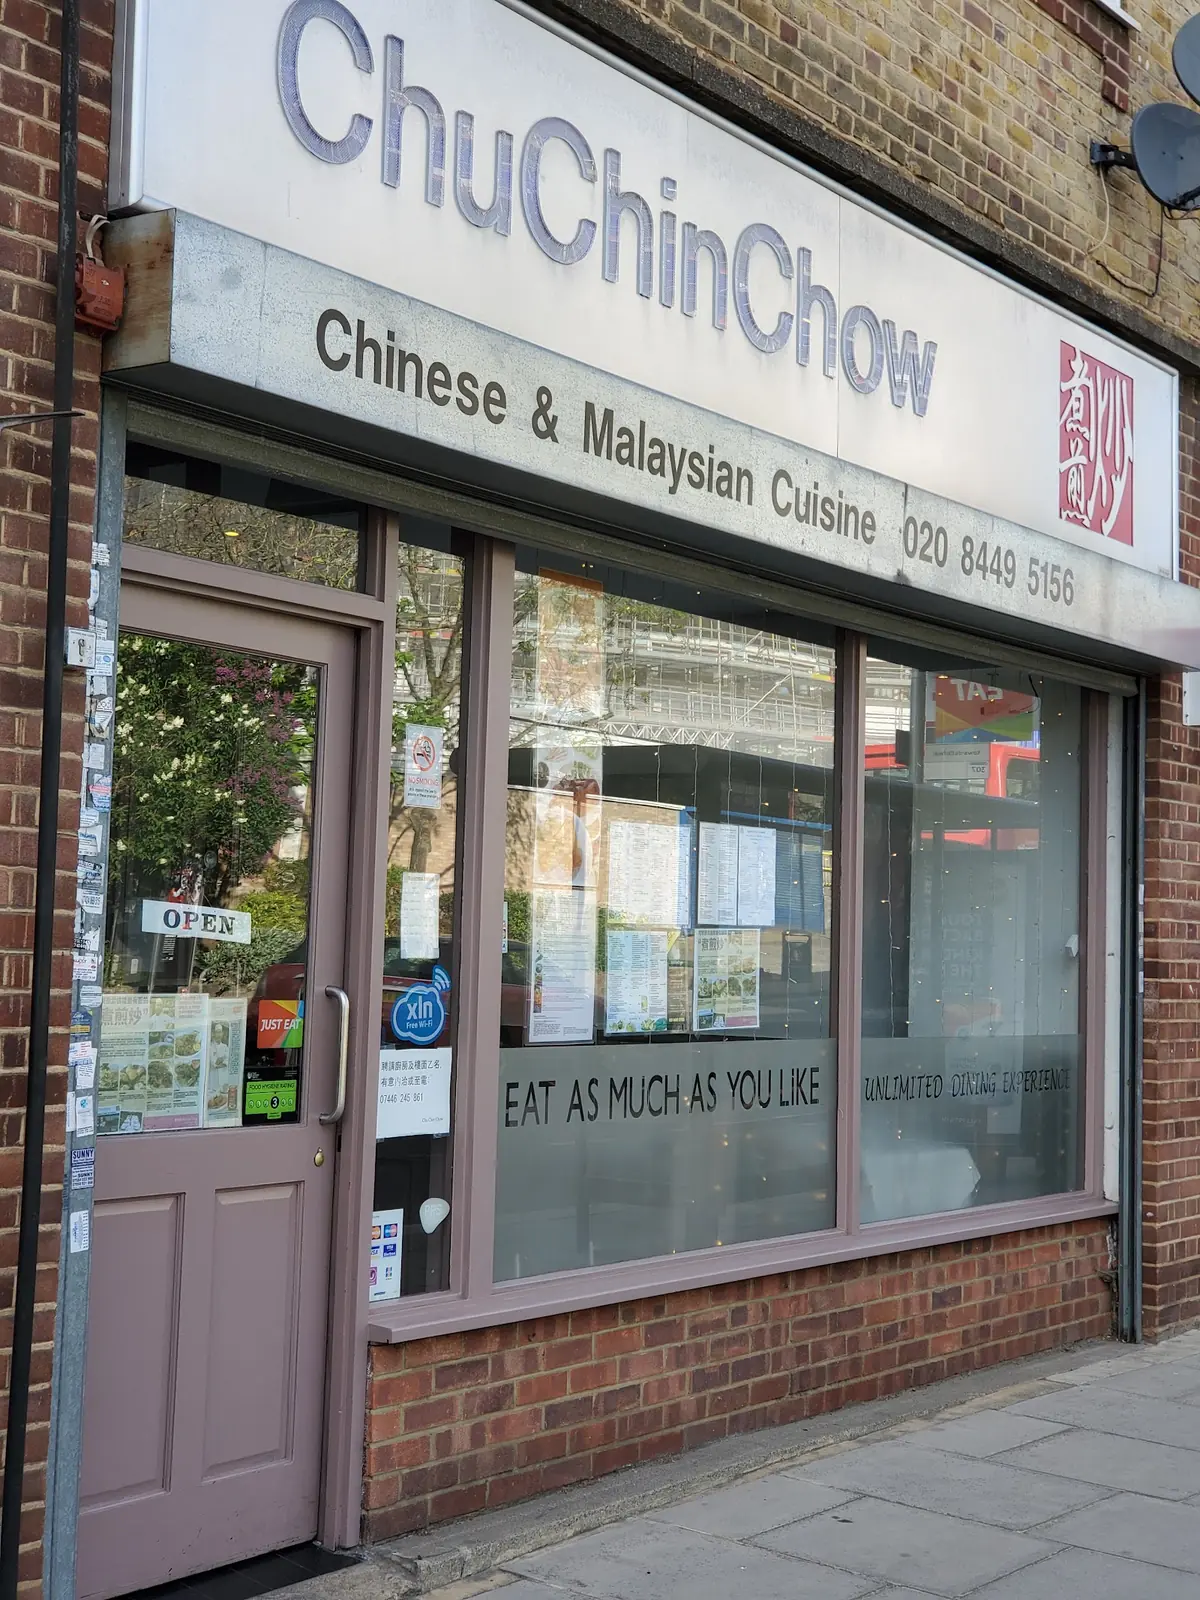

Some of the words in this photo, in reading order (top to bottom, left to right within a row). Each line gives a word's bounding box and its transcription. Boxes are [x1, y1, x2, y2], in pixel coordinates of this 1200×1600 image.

[278, 0, 937, 417] ChuChinChow
[316, 308, 507, 425] Chinese
[531, 385, 559, 444] &
[583, 400, 754, 506] Malaysian
[771, 468, 877, 545] Cuisine
[903, 515, 948, 568] 020
[961, 535, 1016, 589] 8449
[1027, 556, 1074, 606] 5156
[163, 908, 236, 935] OPEN
[260, 1018, 283, 1032] JUST
[283, 1018, 302, 1030] EAT
[406, 1021, 418, 1029] Free
[419, 1020, 433, 1028] Wi-Fi
[379, 1094, 397, 1104] 07446
[400, 1093, 411, 1103] 245
[413, 1092, 423, 1102] 861
[505, 1080, 556, 1127] EAT
[567, 1077, 599, 1123] AS
[609, 1074, 680, 1120] MUCH
[689, 1072, 717, 1113] AS
[726, 1069, 772, 1110] YOU
[864, 1074, 943, 1101] UNLIMITED
[951, 1071, 996, 1099] DINING
[1002, 1068, 1071, 1095] EXPERIENCE
[72, 1149, 94, 1160] SUNNY
